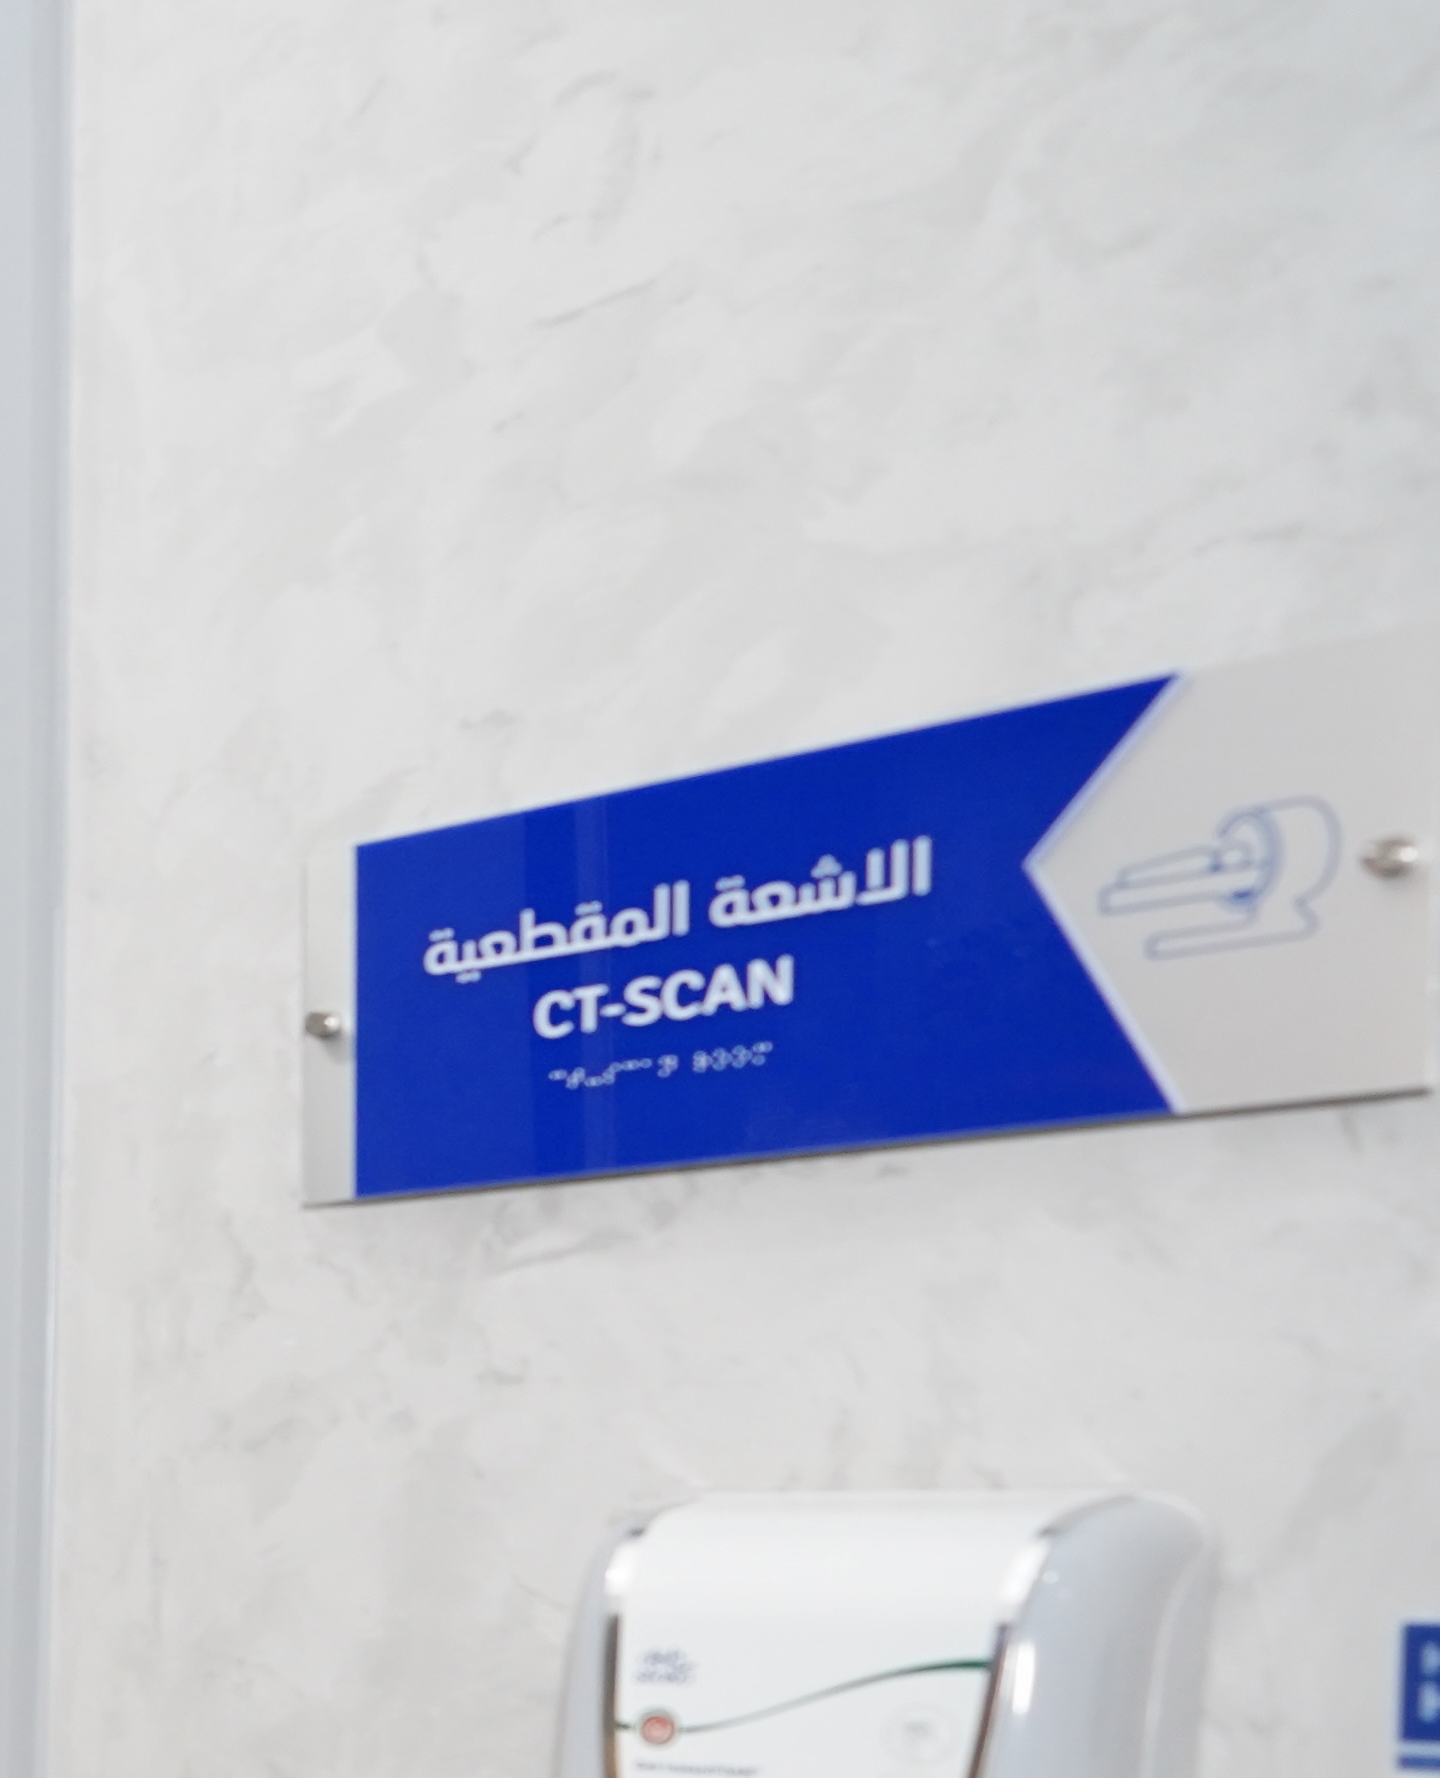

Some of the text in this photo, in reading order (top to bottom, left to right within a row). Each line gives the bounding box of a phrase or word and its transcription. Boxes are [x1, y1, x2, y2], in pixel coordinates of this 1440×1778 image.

[423, 834, 933, 984] الاشعة المقطعية
[532, 953, 796, 1040] CT-SCAN
